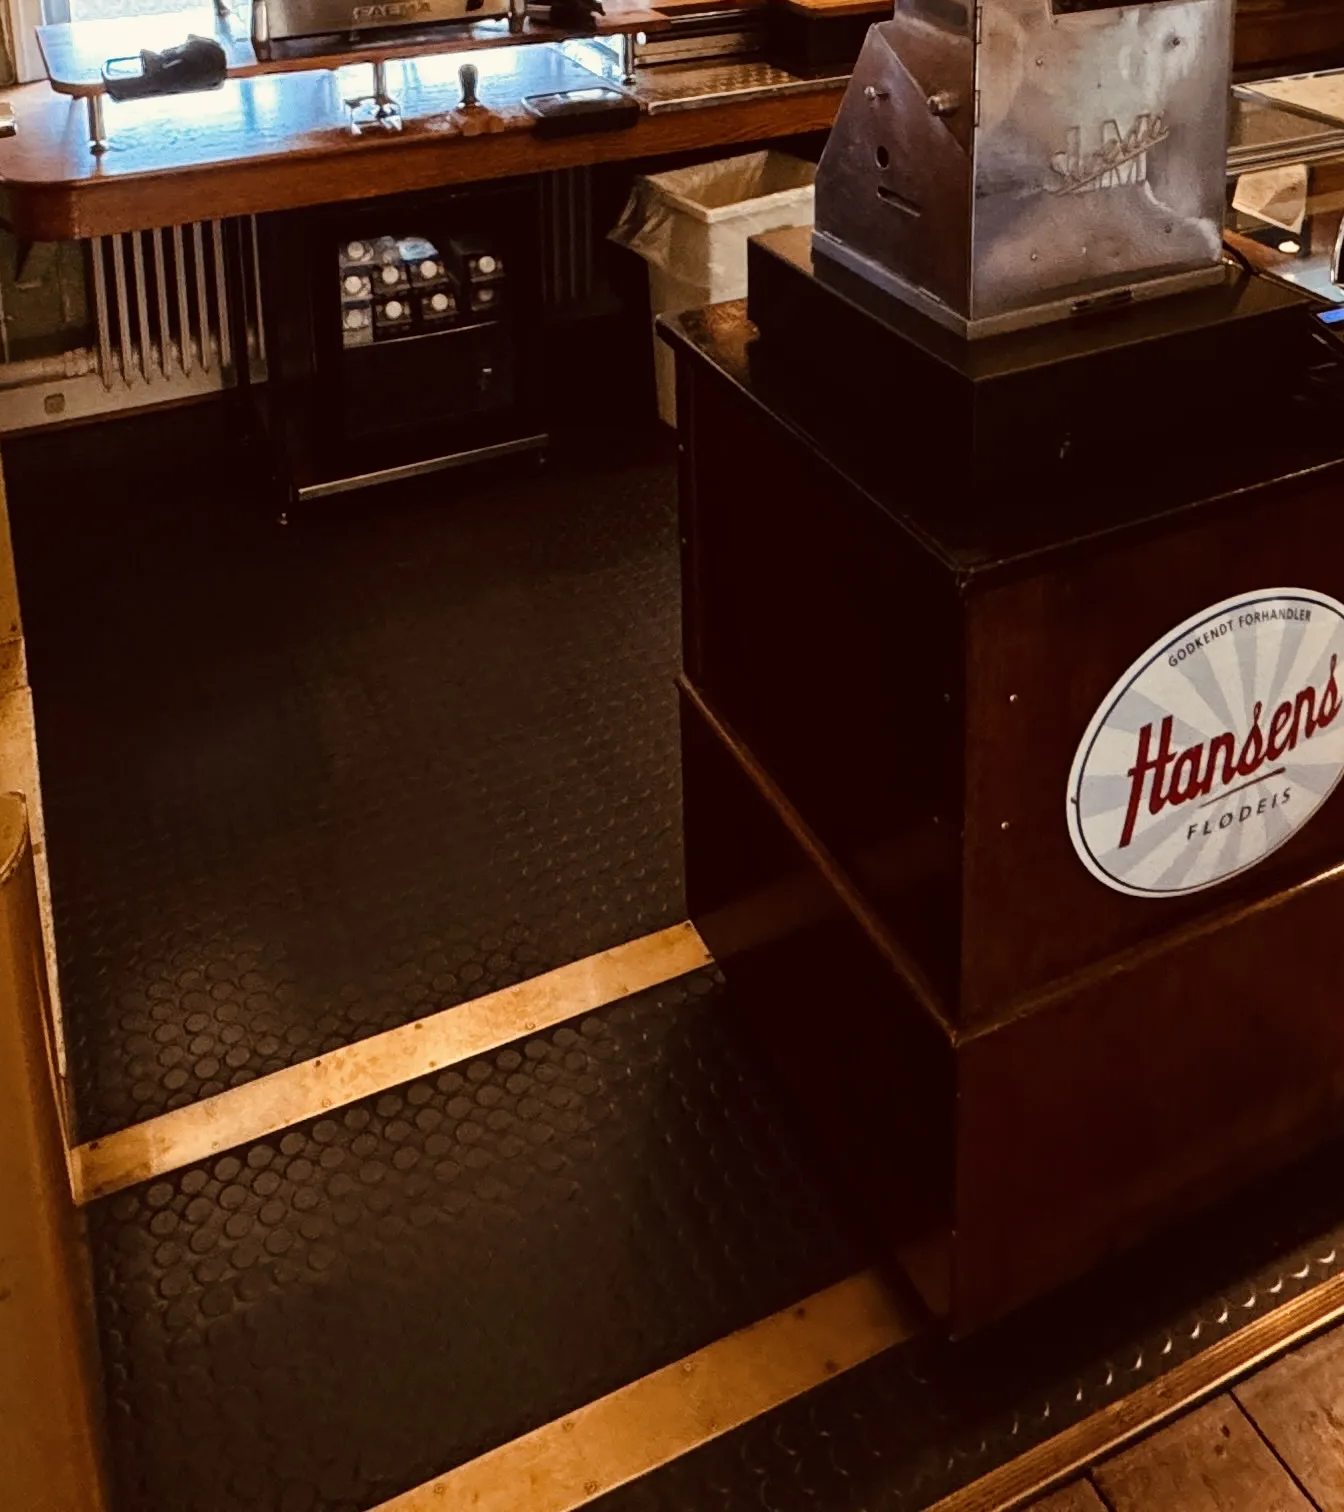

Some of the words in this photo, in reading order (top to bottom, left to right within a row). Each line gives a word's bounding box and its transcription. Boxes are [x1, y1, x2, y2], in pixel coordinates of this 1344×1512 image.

[1168, 619, 1234, 668] GODKENDT
[1238, 608, 1312, 628] FORHANDLER
[1118, 653, 1343, 849] Hansens
